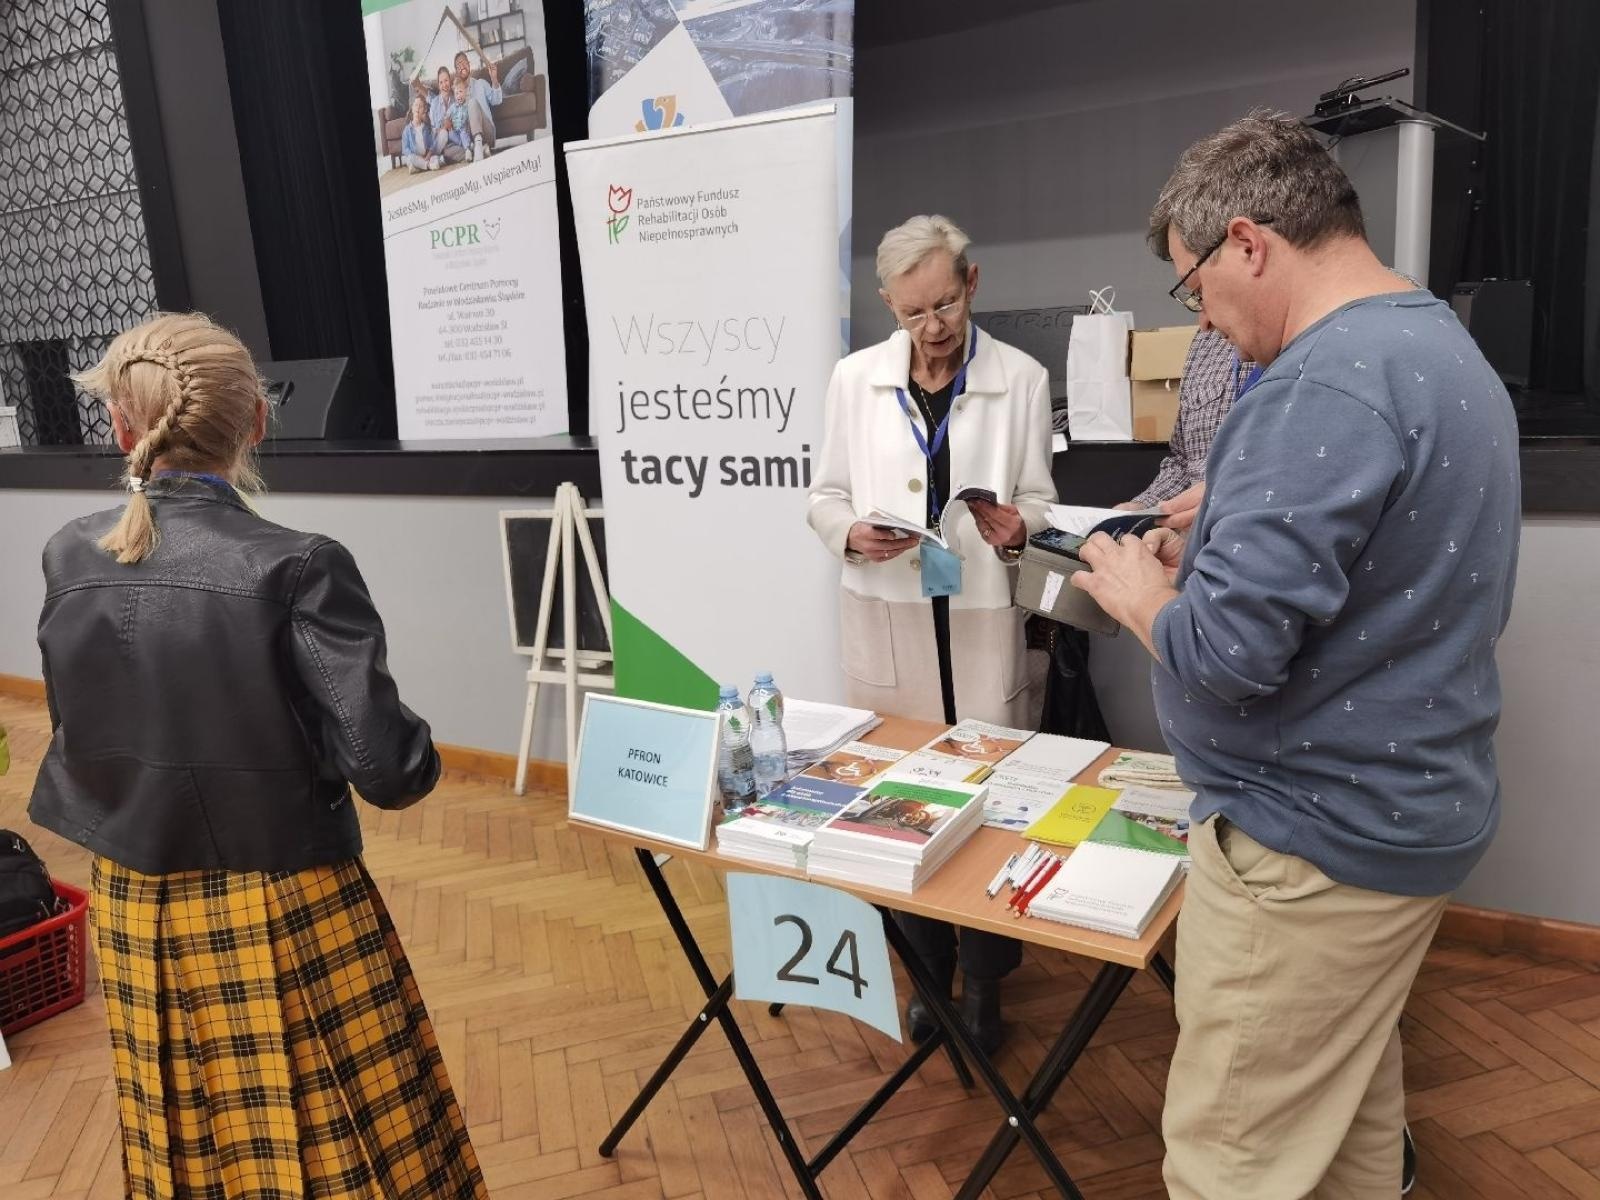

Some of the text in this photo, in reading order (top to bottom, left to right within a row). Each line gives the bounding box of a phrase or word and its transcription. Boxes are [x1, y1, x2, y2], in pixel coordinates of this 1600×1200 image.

[637, 188, 740, 209] Państwowy Fundusz
[638, 205, 728, 226] Rehabilitacji Osób
[430, 223, 480, 249] PCPR
[612, 313, 786, 367] Wszyscy
[616, 374, 796, 434] jesteśmy
[620, 444, 811, 499] tacy sami
[627, 748, 662, 765] PFRON
[618, 767, 669, 788] KATOWICE
[774, 914, 869, 999] 24
